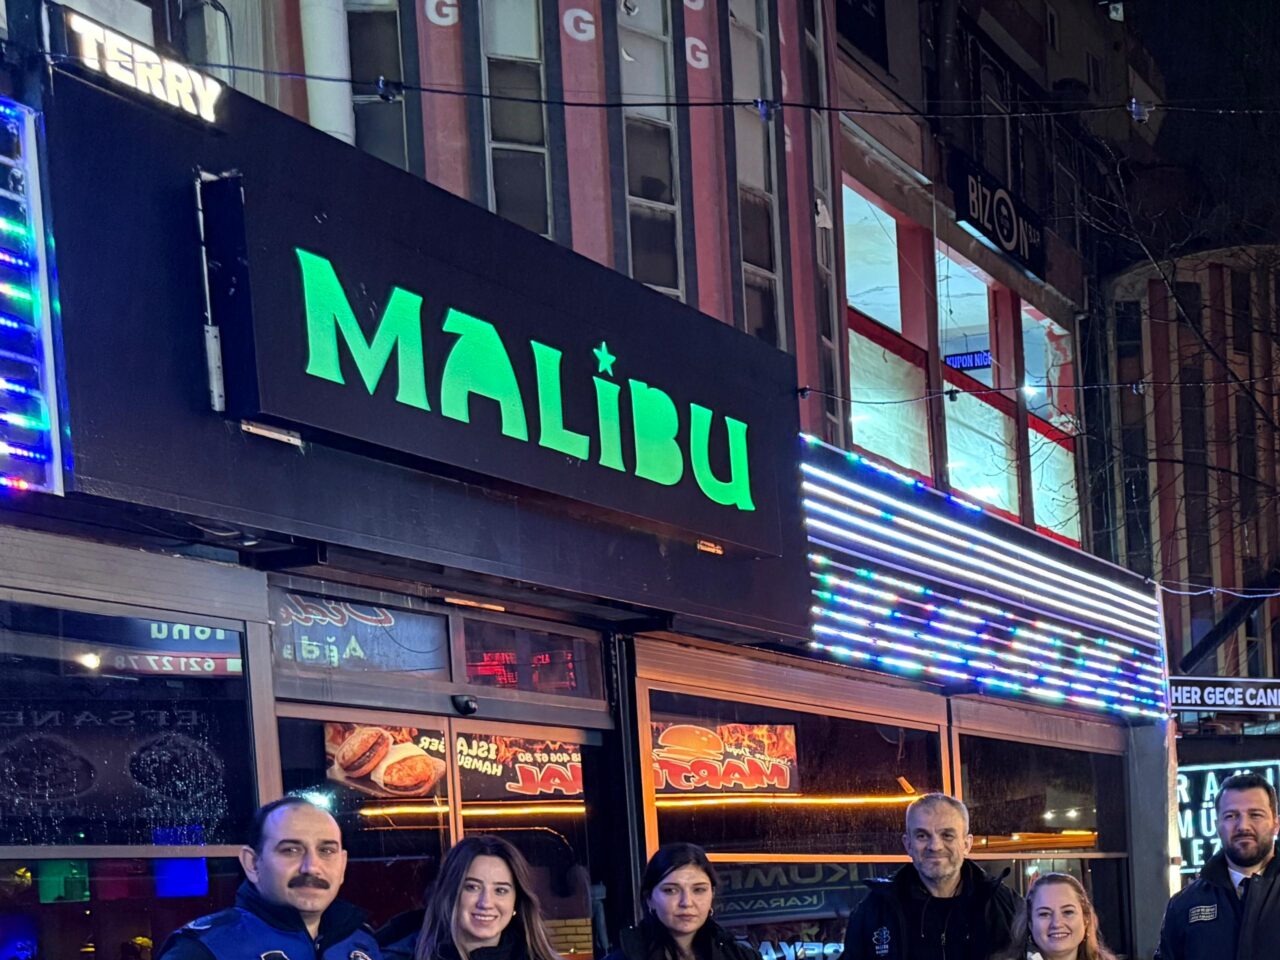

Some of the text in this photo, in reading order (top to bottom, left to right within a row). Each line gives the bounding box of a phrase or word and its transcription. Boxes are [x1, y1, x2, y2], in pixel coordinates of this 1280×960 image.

[70, 12, 222, 123] TERRY
[1171, 686, 1201, 704] HER
[1203, 687, 1243, 705] GECE
